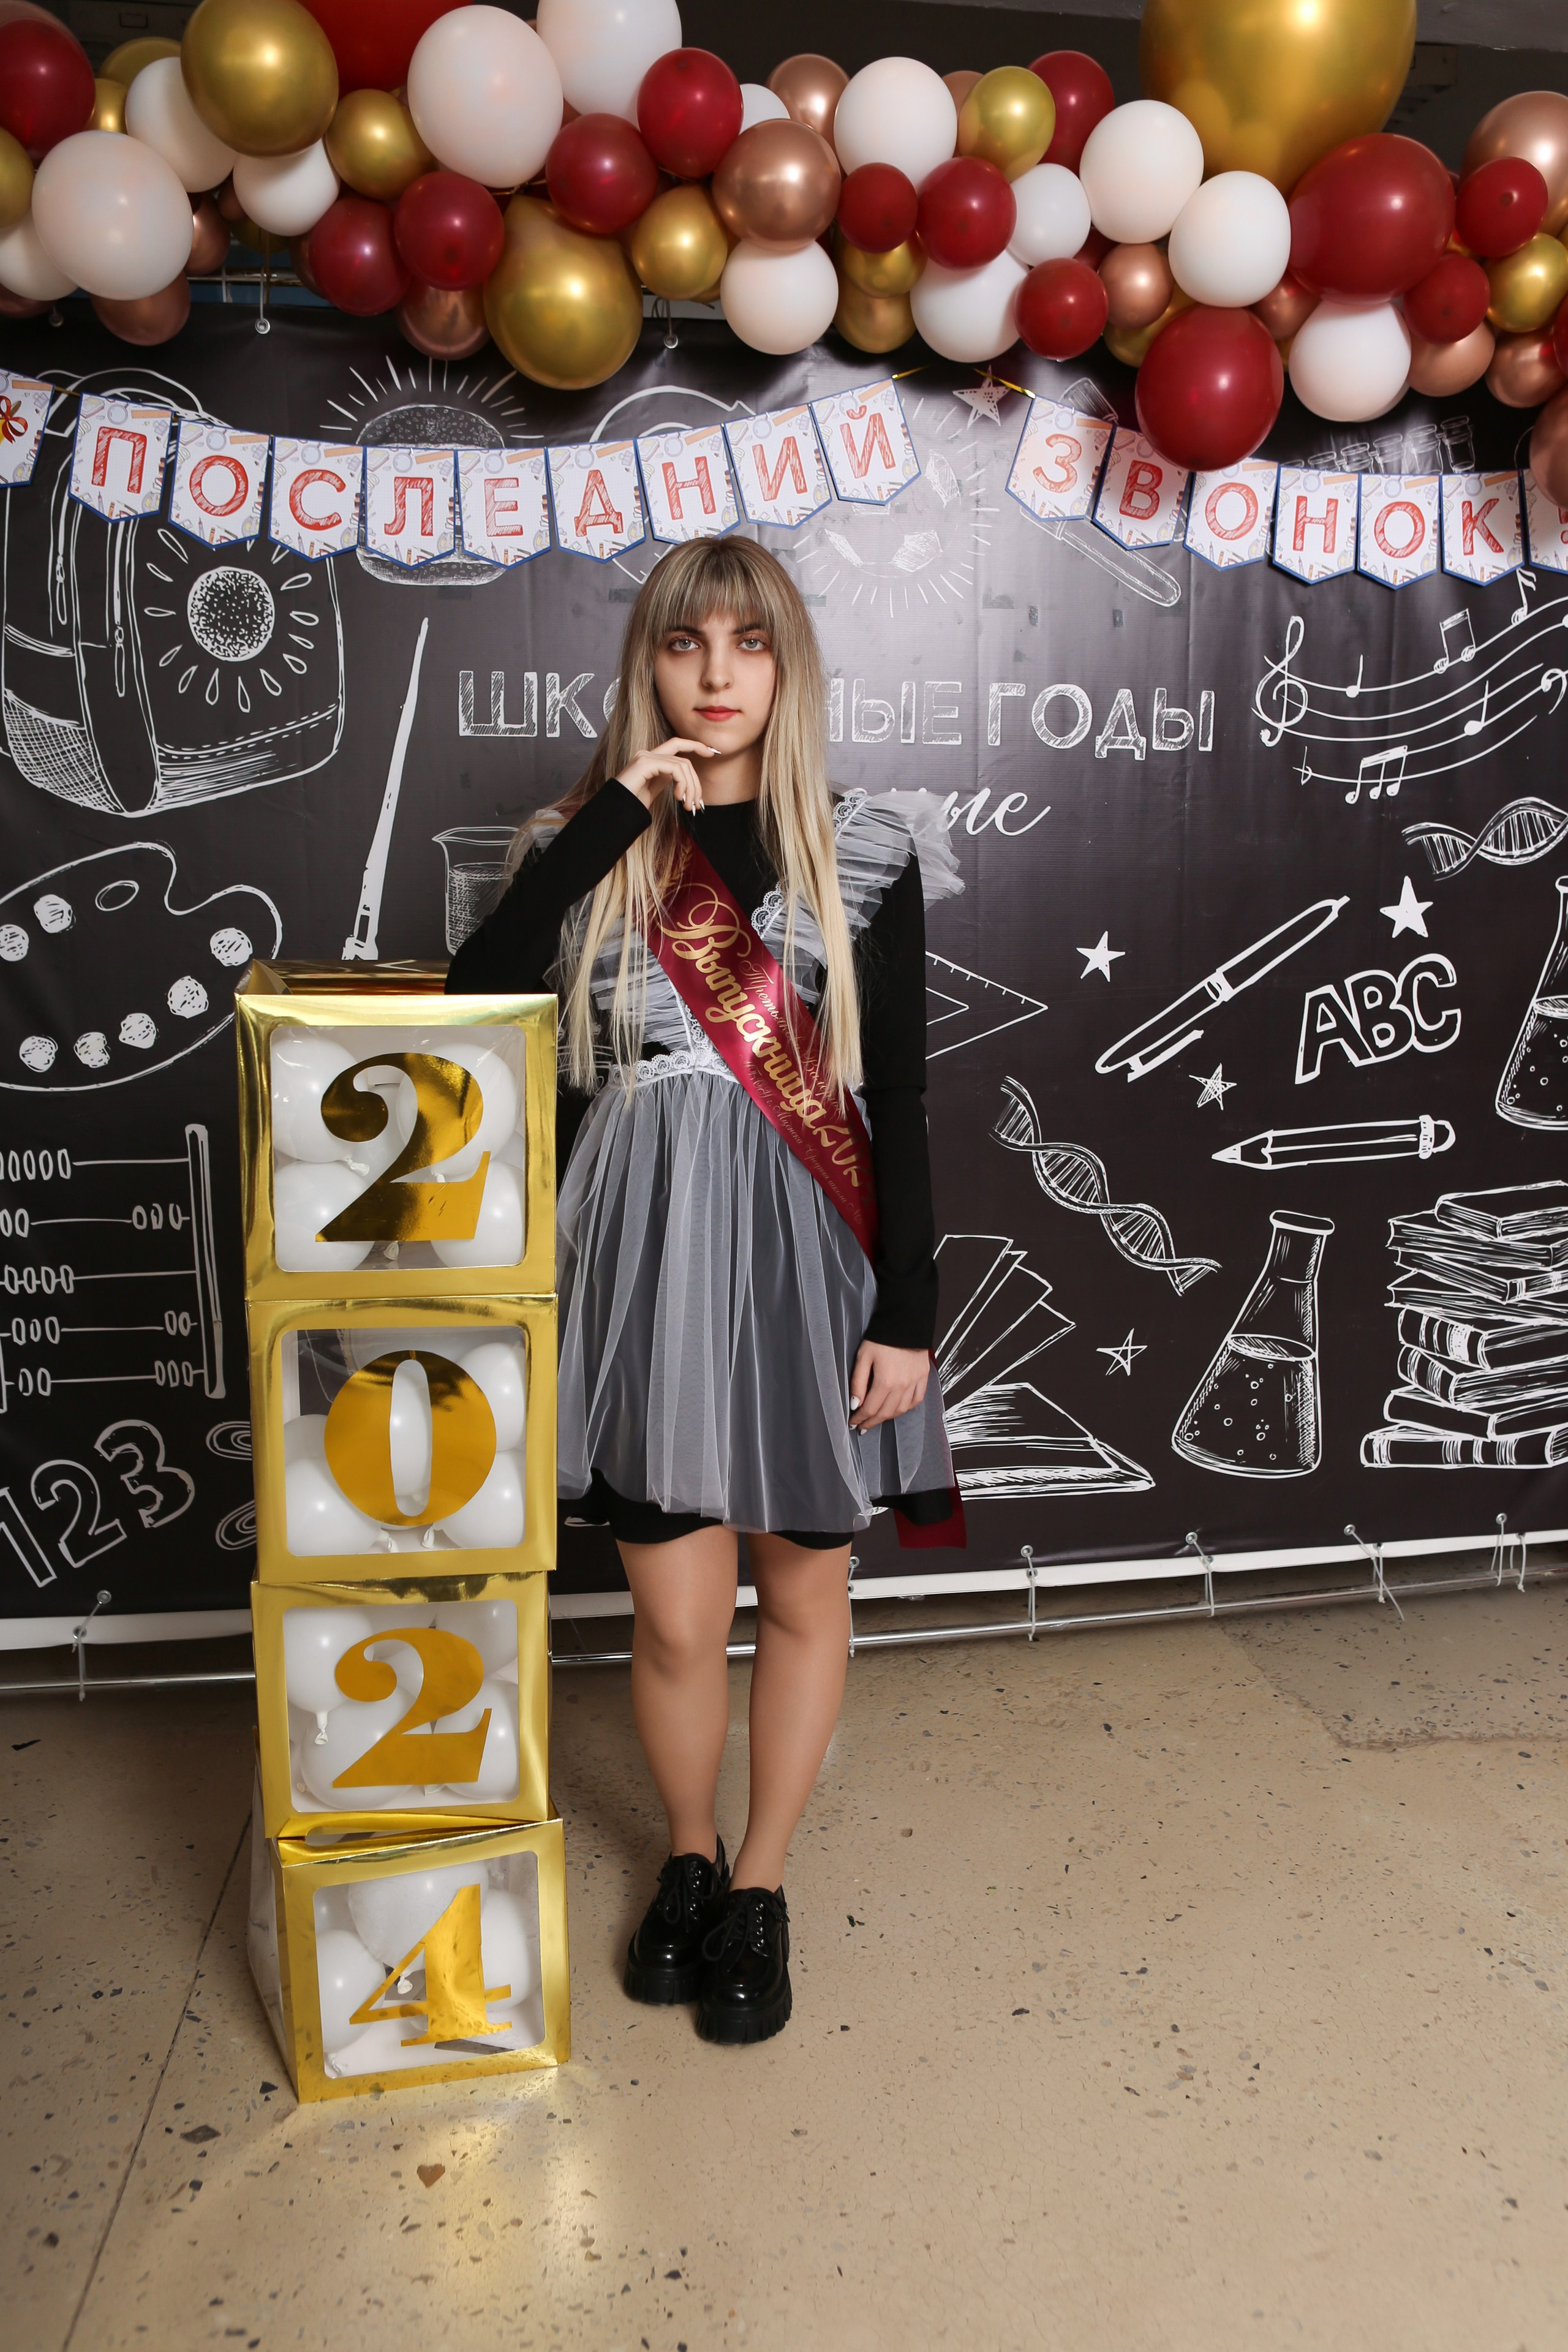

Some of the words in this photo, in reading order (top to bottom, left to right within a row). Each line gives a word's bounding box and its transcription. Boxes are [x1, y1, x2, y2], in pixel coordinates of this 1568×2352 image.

[91, 405, 896, 538] ПОСЛЕДНИЙ
[988, 682, 1215, 760] ГОДЫ
[653, 883, 827, 1129] Выпускница
[1295, 953, 1461, 1084] ABC
[0, 1419, 195, 1588] 123
